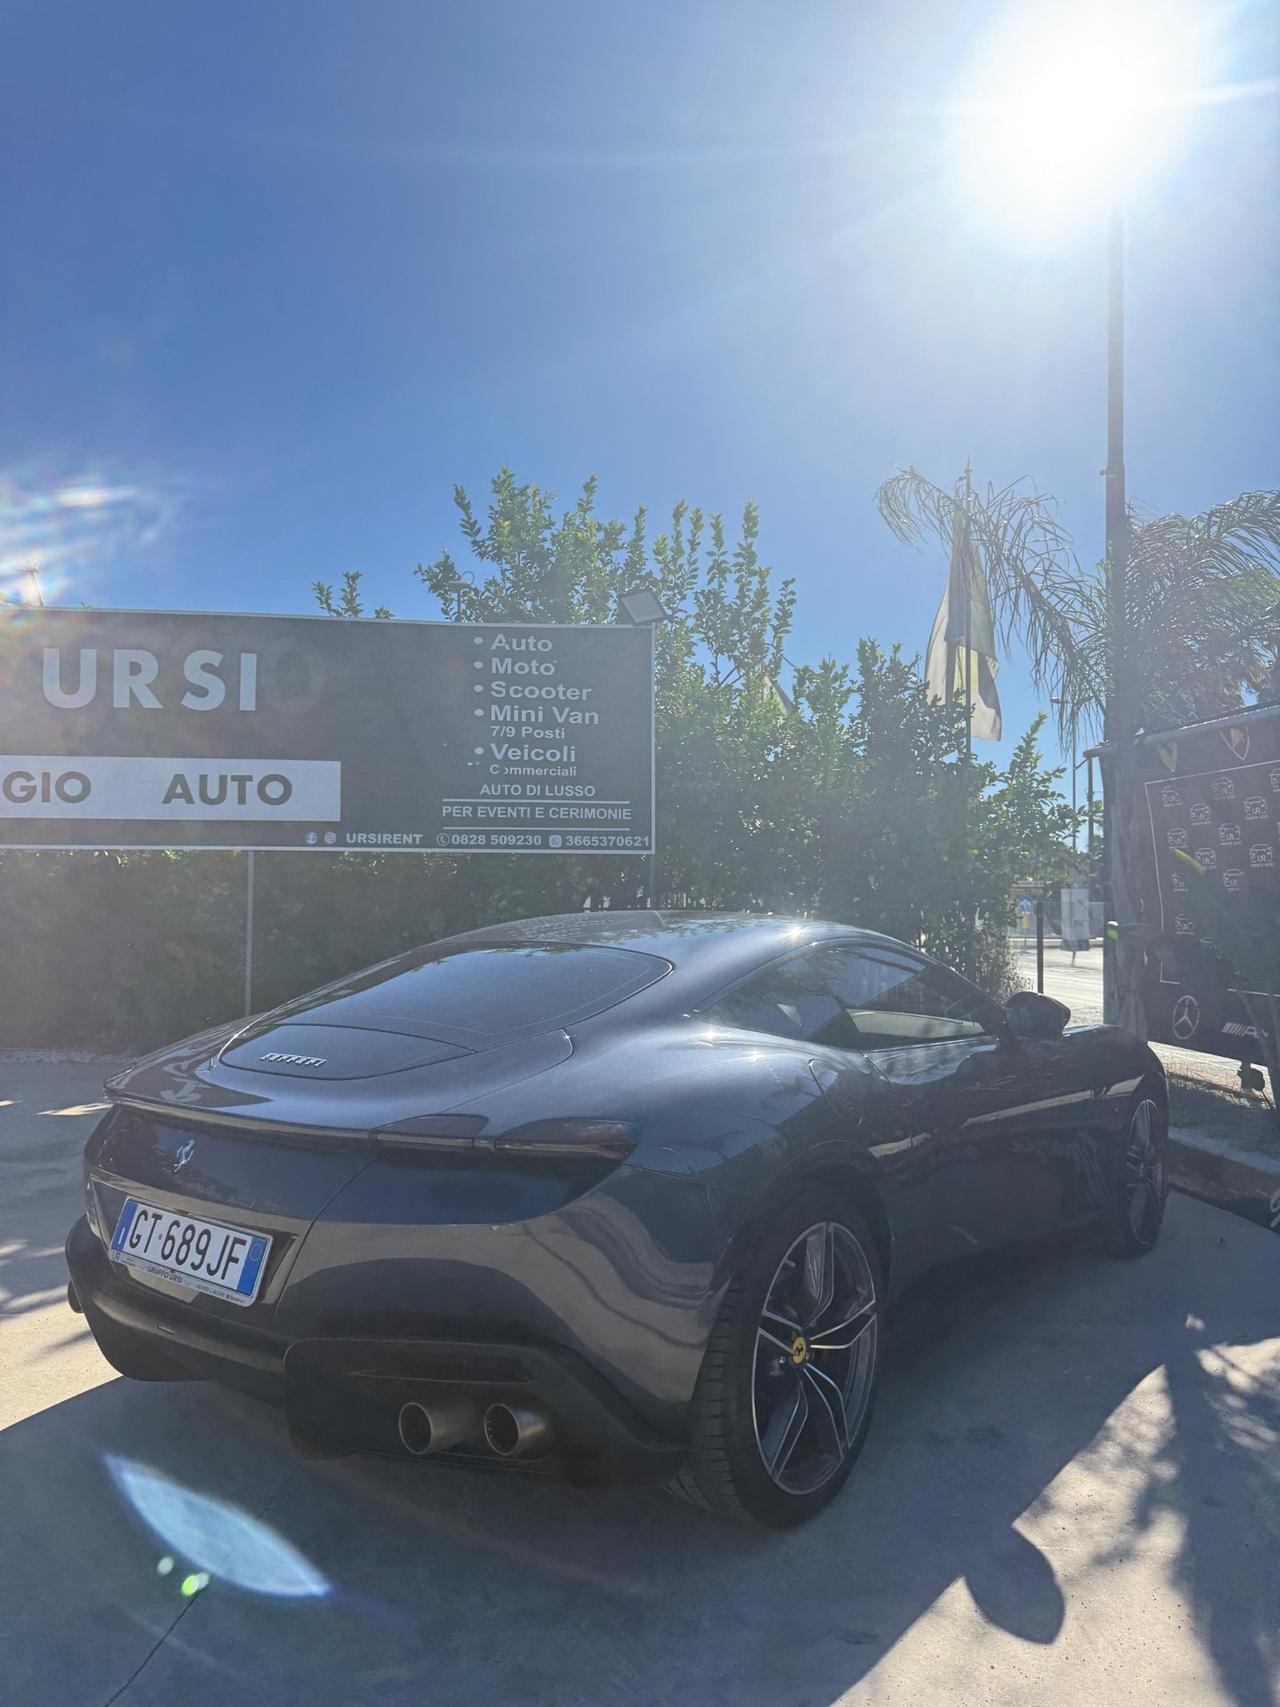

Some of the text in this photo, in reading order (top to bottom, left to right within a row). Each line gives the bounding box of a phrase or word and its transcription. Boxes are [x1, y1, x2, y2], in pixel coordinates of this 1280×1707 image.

[490, 634, 552, 652] Auto
[491, 657, 556, 676] Moto
[490, 681, 593, 701] Scooter
[490, 704, 599, 725] Mini Van
[490, 725, 565, 739] 7/9 Posti
[490, 743, 576, 762] Veicoli
[162, 773, 293, 806] AUTO
[480, 784, 596, 797] AUTO DI LUSSO
[442, 806, 632, 820] PER EVENTI E CERIMONIE
[346, 832, 650, 847] URSIRENT 0828 509230 3665370621
